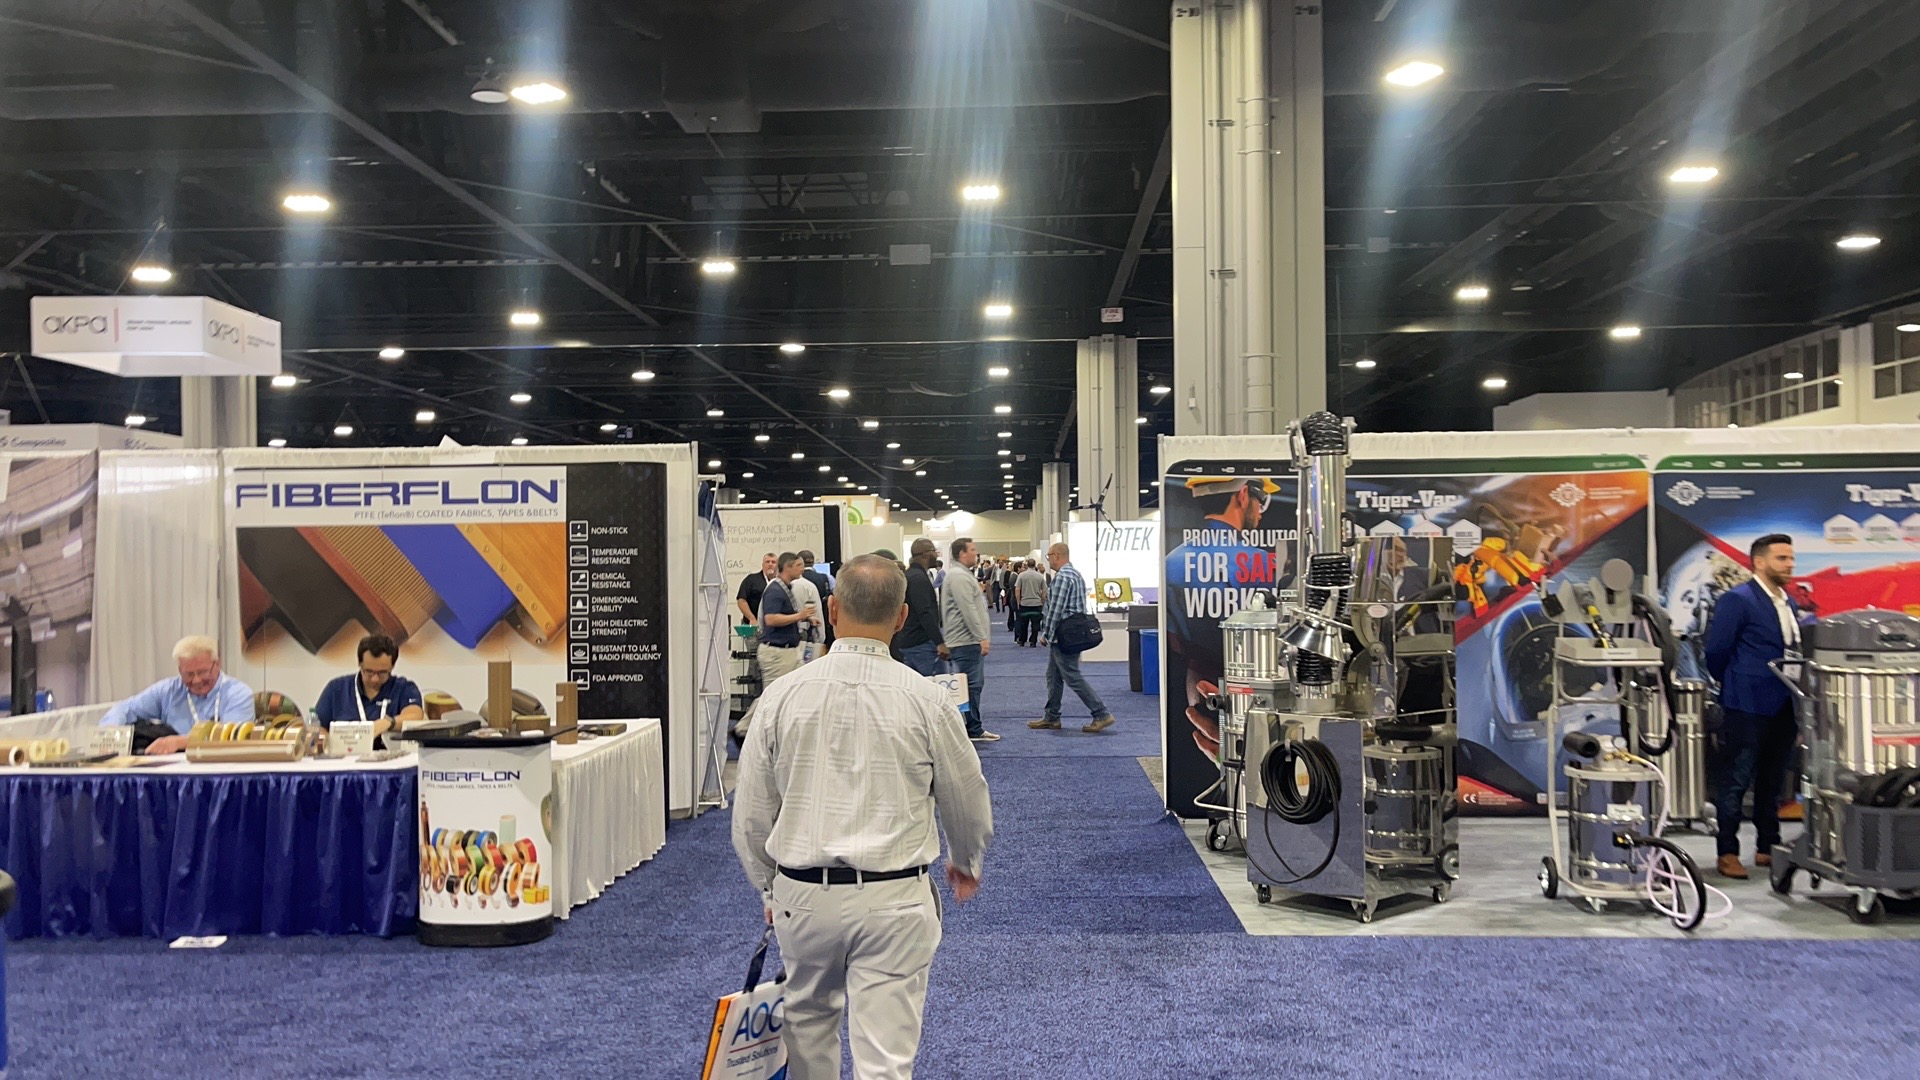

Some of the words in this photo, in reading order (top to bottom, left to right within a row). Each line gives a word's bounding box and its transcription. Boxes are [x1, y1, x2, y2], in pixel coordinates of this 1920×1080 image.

[354, 511, 375, 520] PTFE
[416, 509, 453, 518] COATED
[455, 508, 494, 519] FABRICS,
[497, 508, 524, 517] TAPES
[591, 527, 628, 535] NON-STICK
[722, 524, 784, 535] ERFORMANCE
[786, 523, 819, 534] PLASTICS
[741, 537, 760, 545] shape
[763, 537, 777, 545] your
[1182, 529, 1238, 547] PROVEN
[1241, 529, 1298, 547] SOLUTIO
[591, 548, 638, 556] TEMPERATURE
[591, 557, 631, 565] RESISTANCE
[726, 560, 744, 569] GAS
[1184, 552, 1229, 583] FOR
[1235, 552, 1277, 583] SAF
[591, 572, 626, 580] CHEMICAL
[591, 581, 631, 589] RESISTANCE
[591, 596, 638, 604] DIMENSIONAL
[1184, 587, 1278, 618] WORK
[592, 605, 622, 613] STABILITY
[609, 619, 648, 627] DIELECTRIC
[592, 628, 627, 636] STRENGTH
[592, 645, 626, 653] RESISTANT
[639, 644, 650, 653] UV,
[599, 653, 620, 661] RADIO
[621, 652, 662, 661] FREQUENCY
[592, 674, 607, 682] FDA
[607, 674, 643, 682] APPROVED
[422, 770, 521, 782] FIBERFLON
[731, 996, 785, 1046] AOC
